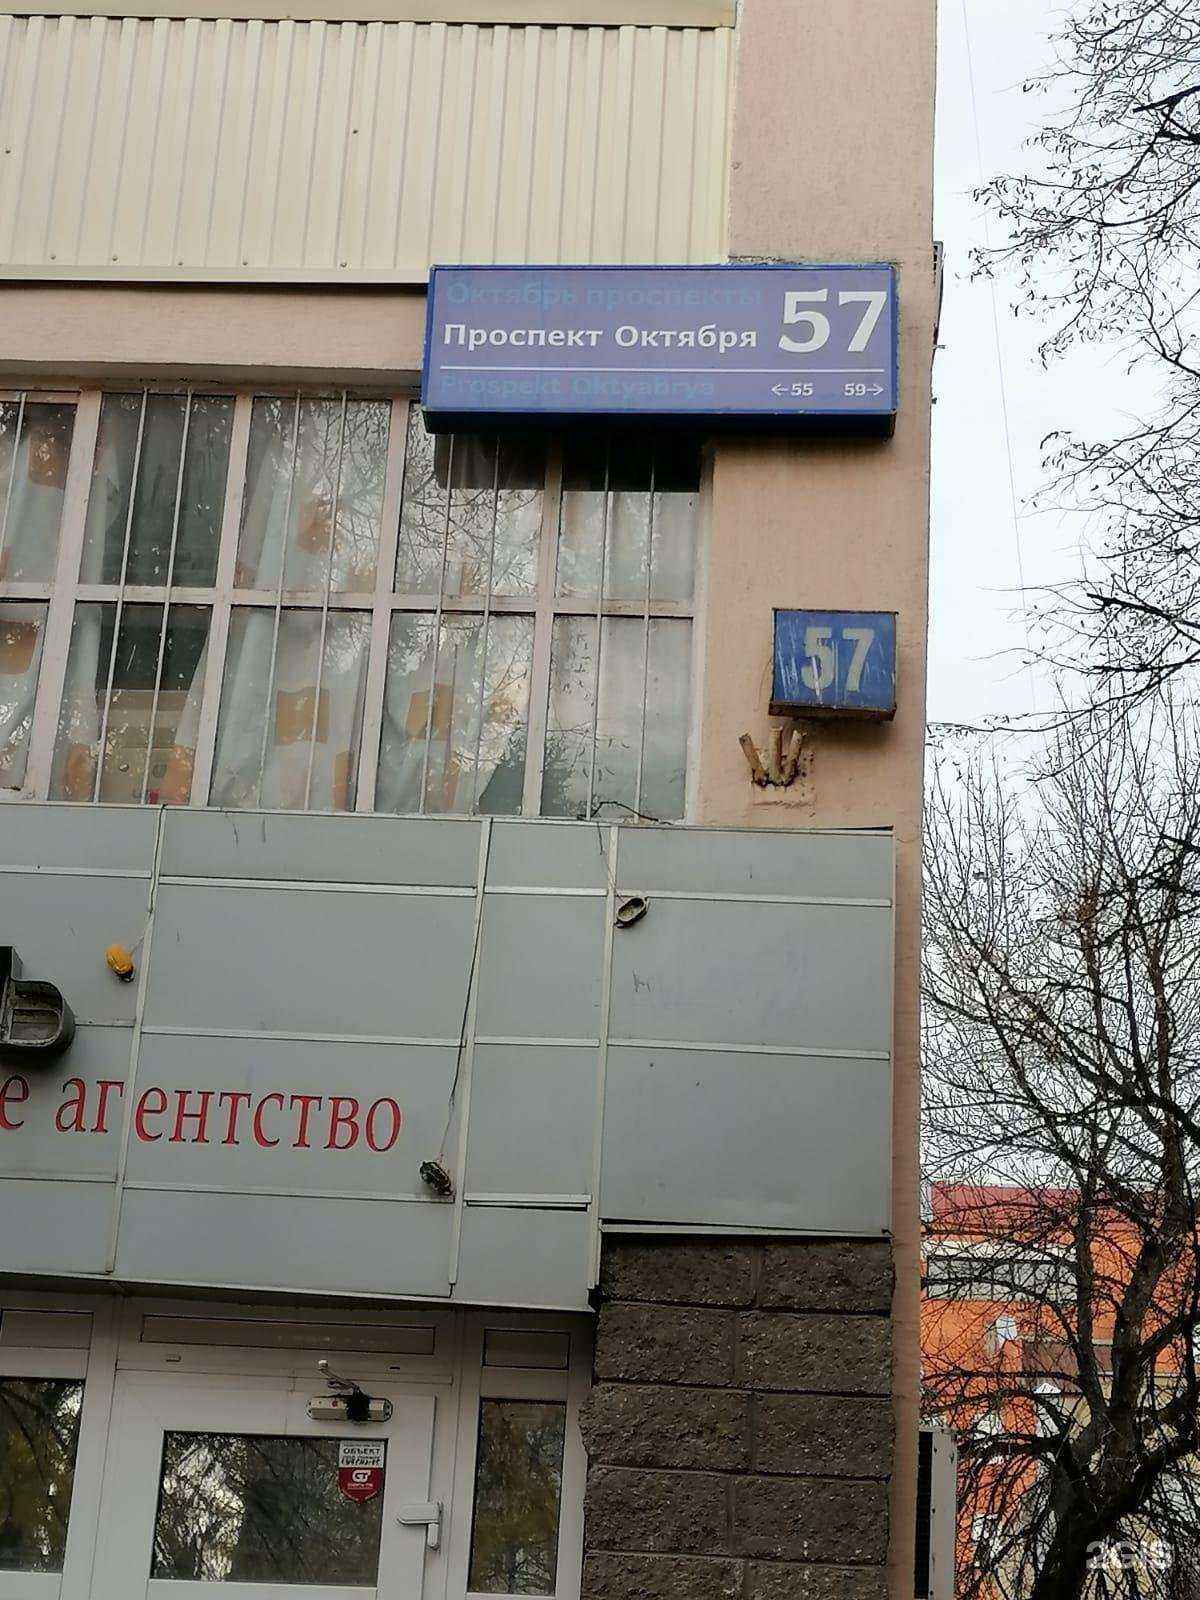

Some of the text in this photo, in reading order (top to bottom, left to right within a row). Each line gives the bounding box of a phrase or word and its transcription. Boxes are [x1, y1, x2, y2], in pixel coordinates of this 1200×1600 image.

[447, 280, 762, 312] Октябрь проспекты
[778, 288, 888, 353] 57
[443, 323, 759, 354] Проспект Октября
[440, 374, 716, 401] Prospekt Oktyabrya
[790, 382, 867, 397] 55 59
[800, 626, 875, 692] 57
[54, 1076, 403, 1153] агентство
